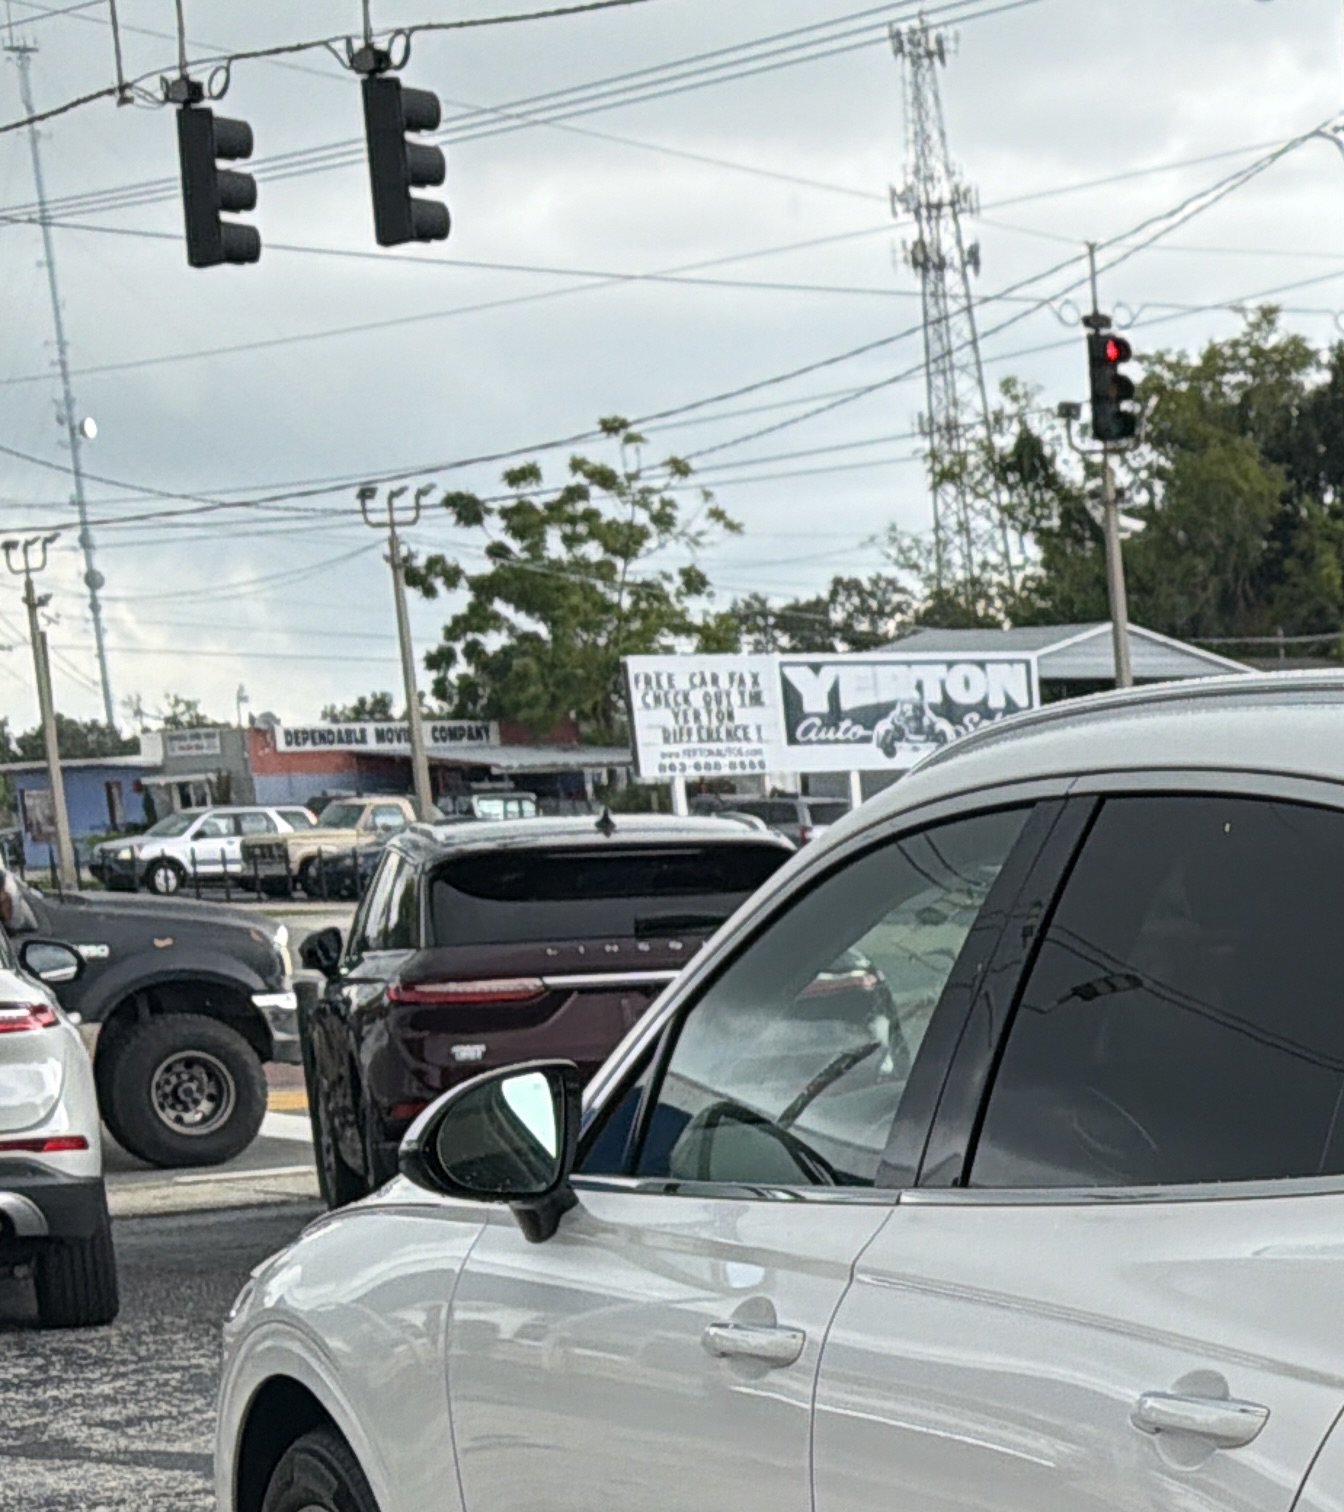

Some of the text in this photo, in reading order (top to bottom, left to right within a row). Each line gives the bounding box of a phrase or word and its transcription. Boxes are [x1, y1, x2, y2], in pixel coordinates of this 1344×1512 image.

[633, 671, 675, 690] FREE
[781, 663, 1029, 714] YERTON
[641, 689, 691, 710] CHECK
[702, 690, 733, 708] OUT
[671, 706, 735, 725] YERTON
[284, 727, 368, 747] DEPENDABLE
[431, 724, 490, 744] COMPANY
[795, 717, 868, 742] Auto
